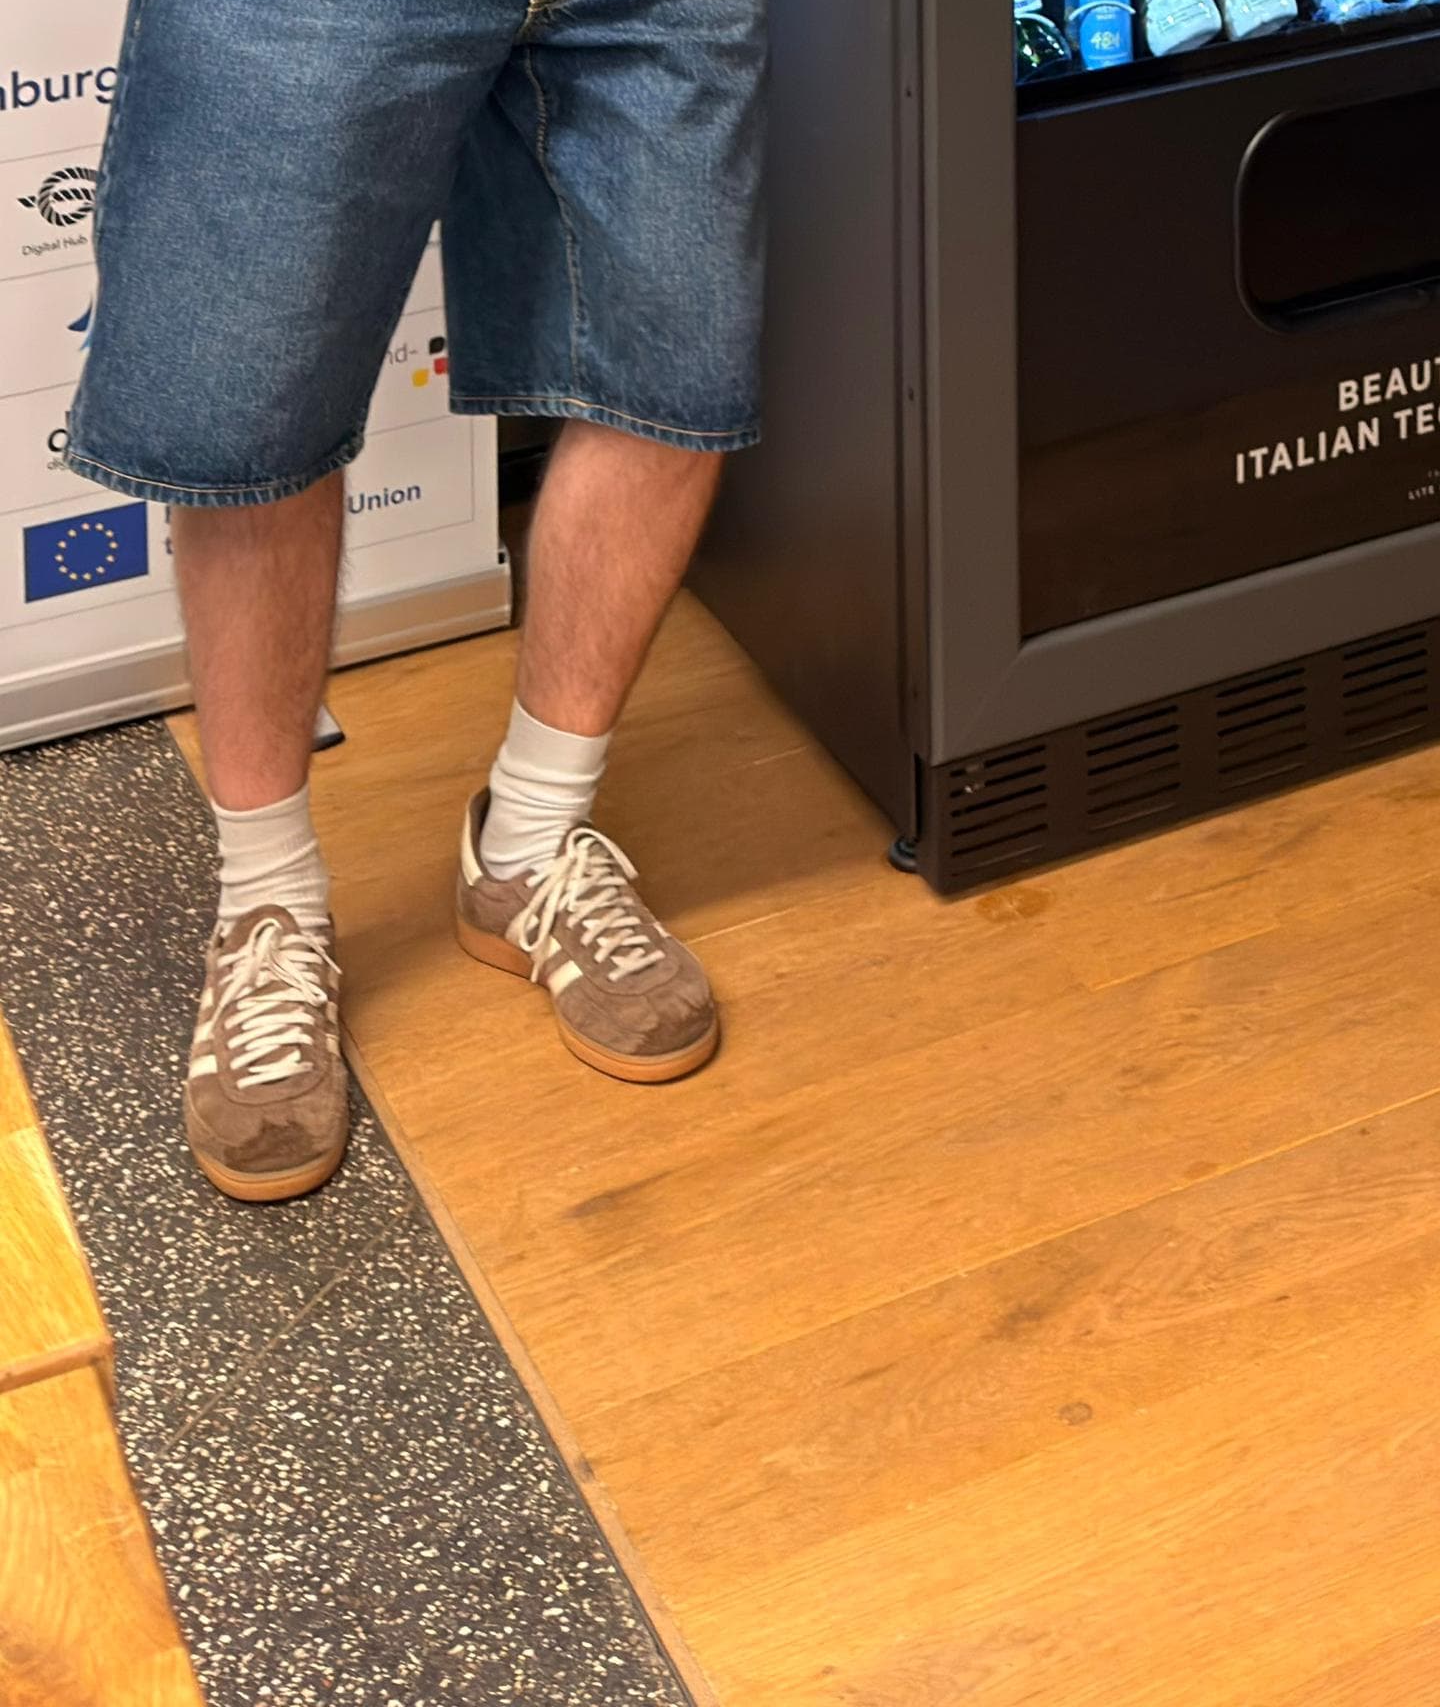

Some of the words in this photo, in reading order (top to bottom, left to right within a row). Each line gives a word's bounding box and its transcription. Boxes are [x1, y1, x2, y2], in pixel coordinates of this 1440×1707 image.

[0, 66, 117, 110] burg
[1235, 418, 1381, 484] ITALIAN
[347, 484, 422, 515] Union
